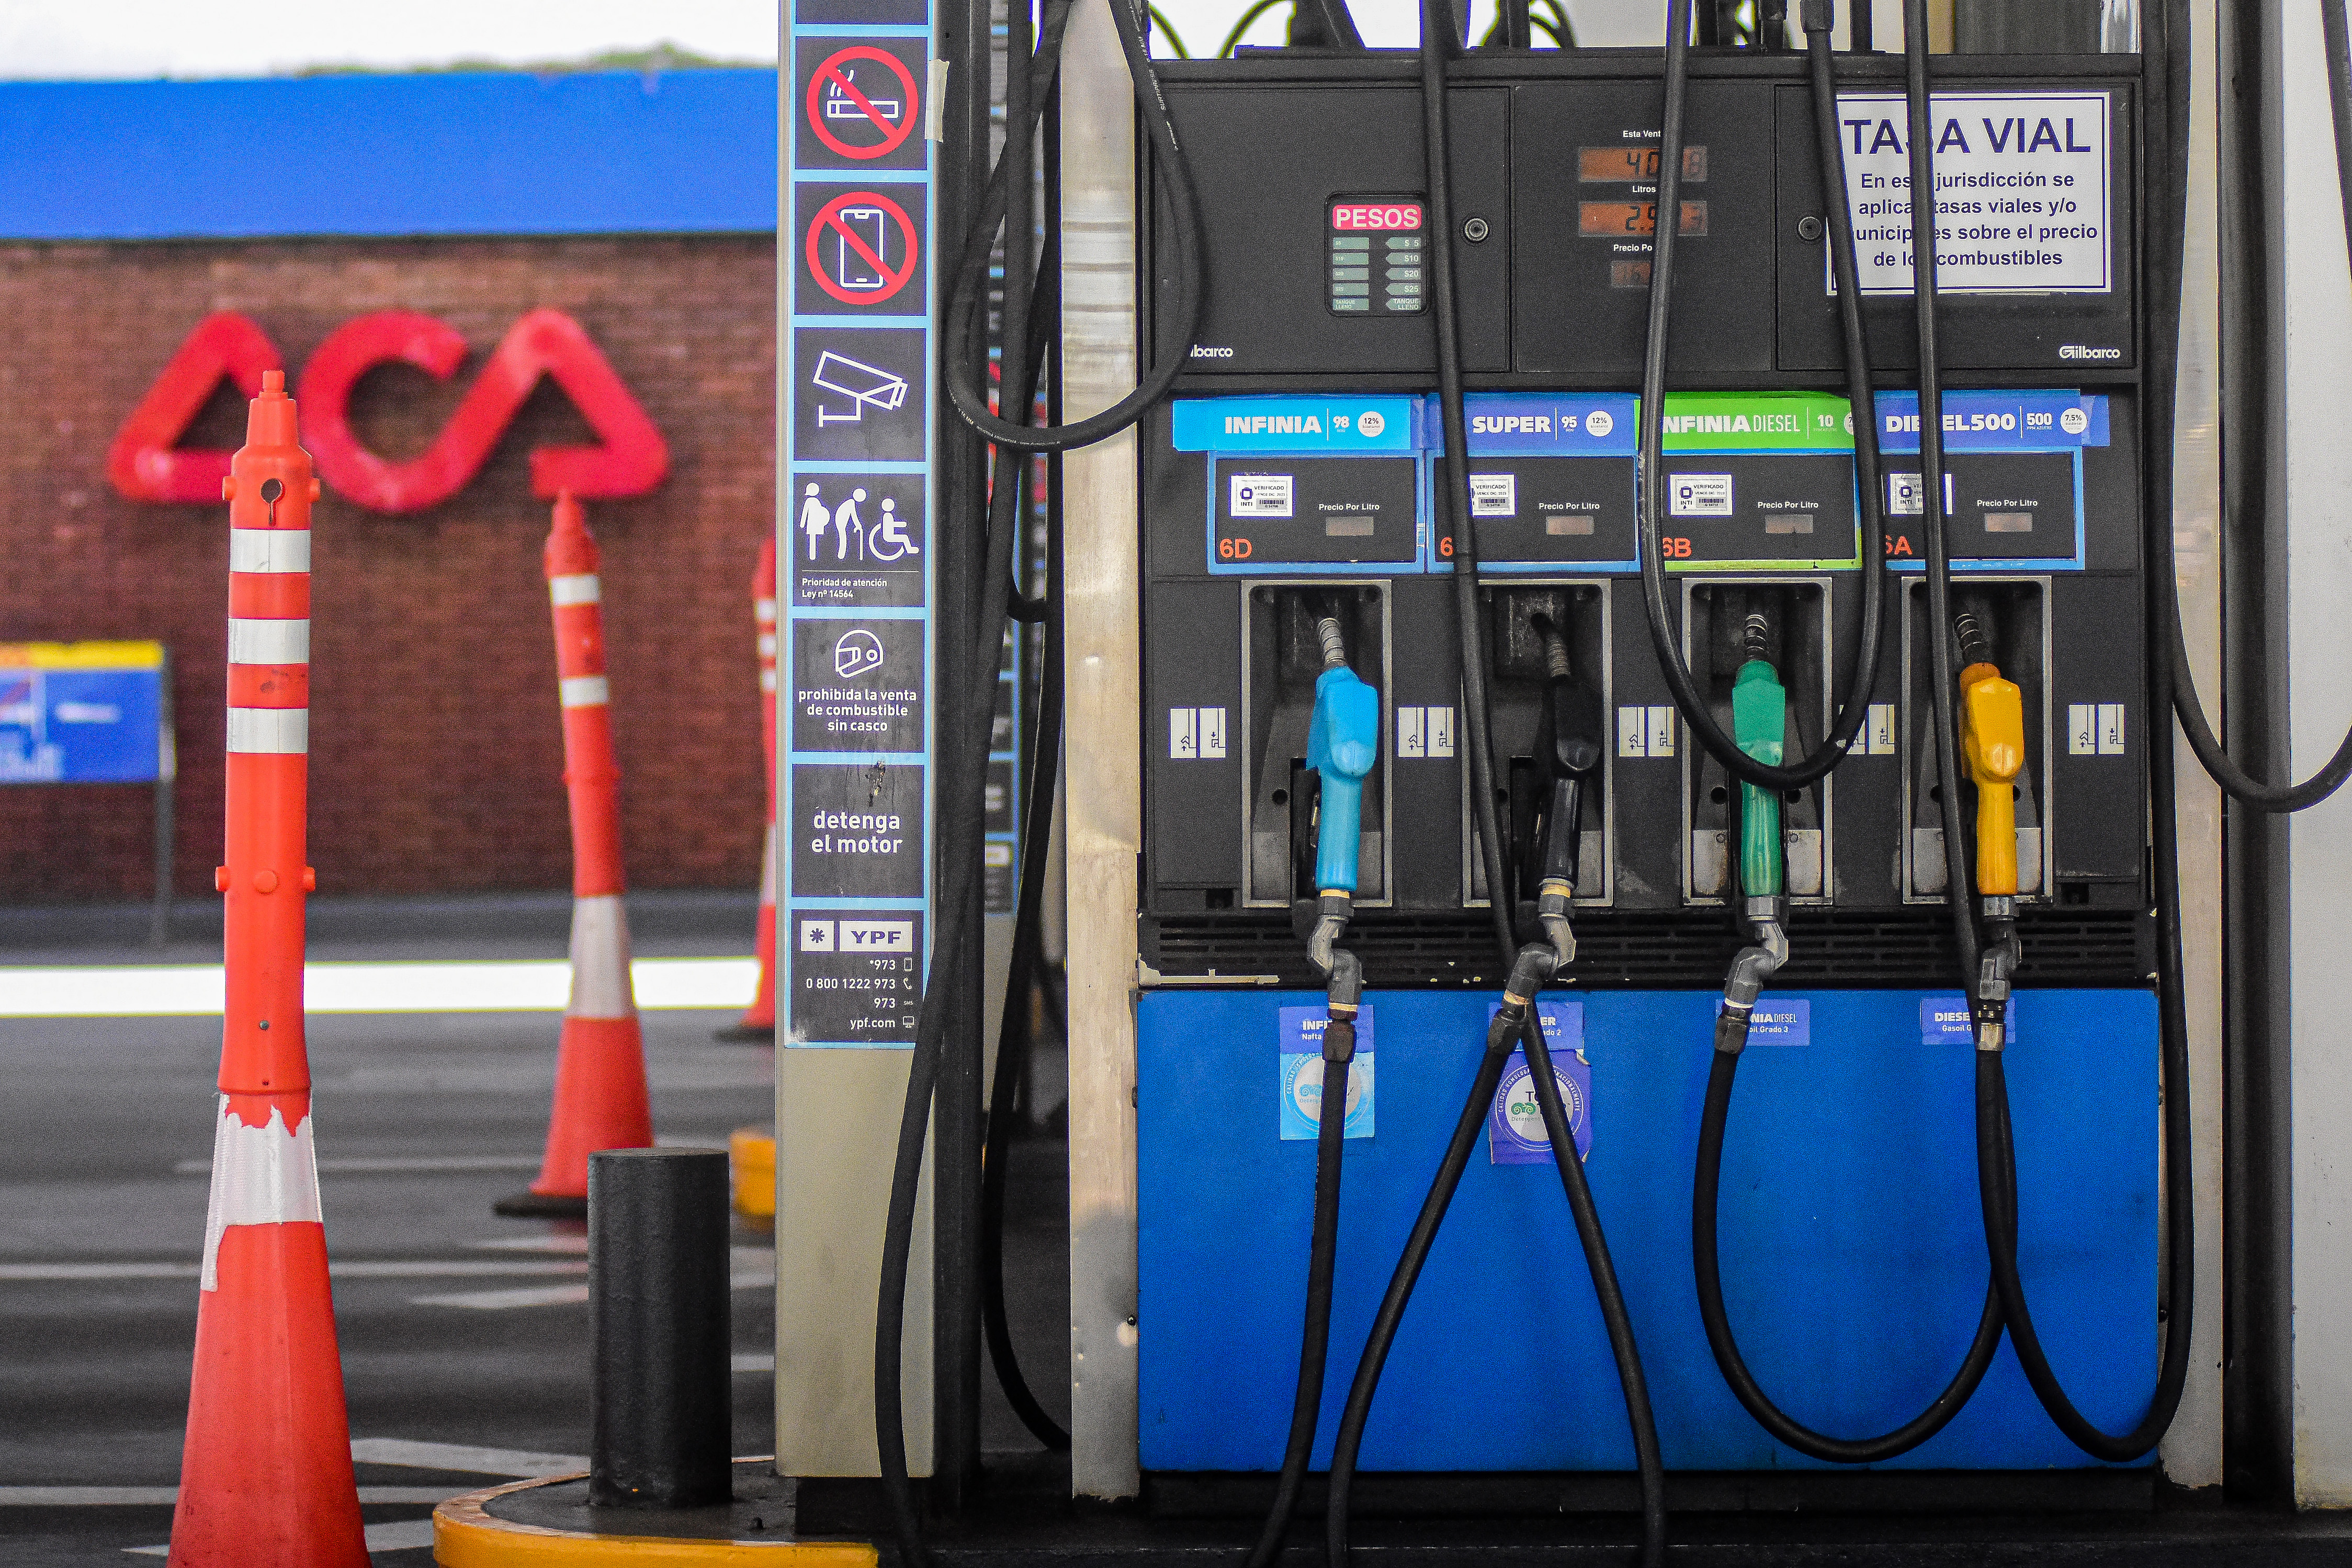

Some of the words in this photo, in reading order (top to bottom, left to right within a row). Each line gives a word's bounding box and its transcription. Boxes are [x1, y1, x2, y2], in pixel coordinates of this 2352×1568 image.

[1844, 118, 1971, 155] TAA
[1982, 118, 2091, 153] VIAL
[1861, 173, 1885, 188] En
[1936, 171, 2046, 191] jurisdicción
[2053, 175, 2074, 187] se
[1859, 199, 1911, 215] aplica
[1934, 200, 1982, 214] tasas
[1988, 198, 2042, 213] viales
[2048, 198, 2077, 216] y/o
[1336, 208, 1419, 228] PESOS
[1856, 224, 1952, 244] unicipes
[1958, 224, 2010, 240] sobre
[2017, 223, 2033, 239] el
[2039, 223, 2098, 243] precio
[1874, 252, 1896, 267] de
[1903, 252, 1915, 267] lo
[1936, 249, 2063, 266] combustibles
[1190, 344, 1234, 358] barco
[2059, 345, 2121, 359] Gilbarco
[110, 309, 670, 513] ACA
[1224, 416, 1322, 434] INFINIA
[1332, 415, 1350, 428] 98
[1472, 416, 1551, 434] SUPER
[1561, 416, 1578, 428] 95
[1664, 415, 1751, 433] NFINIA
[1753, 414, 1800, 433] DIESEL
[1817, 414, 1834, 427] 10
[1886, 413, 2016, 433] DIEEL500
[2027, 413, 2053, 426] 500
[1319, 503, 1344, 512] Precio
[1345, 503, 1360, 511] Por
[1362, 503, 1380, 511] Litro
[1539, 502, 1564, 510] Precio
[1566, 502, 1580, 510] Por
[1977, 499, 2002, 507] Precio
[1219, 538, 1252, 559] 6D
[1440, 537, 1454, 556] 6
[1663, 537, 1692, 558] 6B
[802, 578, 840, 587] Prioridad
[841, 578, 852, 586] de
[853, 578, 888, 587] atención
[802, 590, 816, 599] Ley
[798, 688, 862, 702] prohibida
[865, 688, 877, 701] la
[880, 689, 917, 701] venta
[807, 704, 823, 716] de
[826, 704, 909, 717] combustible
[828, 720, 847, 731] sin
[850, 722, 888, 731] casco
[813, 810, 900, 834] detenga
[811, 834, 832, 853] el
[838, 836, 903, 853] motor
[851, 930, 901, 944] YPF
[806, 978, 813, 989] 0
[816, 978, 838, 989] 800
[842, 978, 870, 989] 1222
[874, 979, 896, 989] 973
[874, 998, 896, 1008] 973
[850, 1017, 896, 1030] ypf.com
[1774, 1014, 1797, 1023] DIESEL
[1935, 1012, 1970, 1022] DIESE
[1303, 1020, 1332, 1030] INFI
[1287, 1070, 1296, 1094] CALIDAD
[1498, 1088, 1508, 1112] CALIDAD
